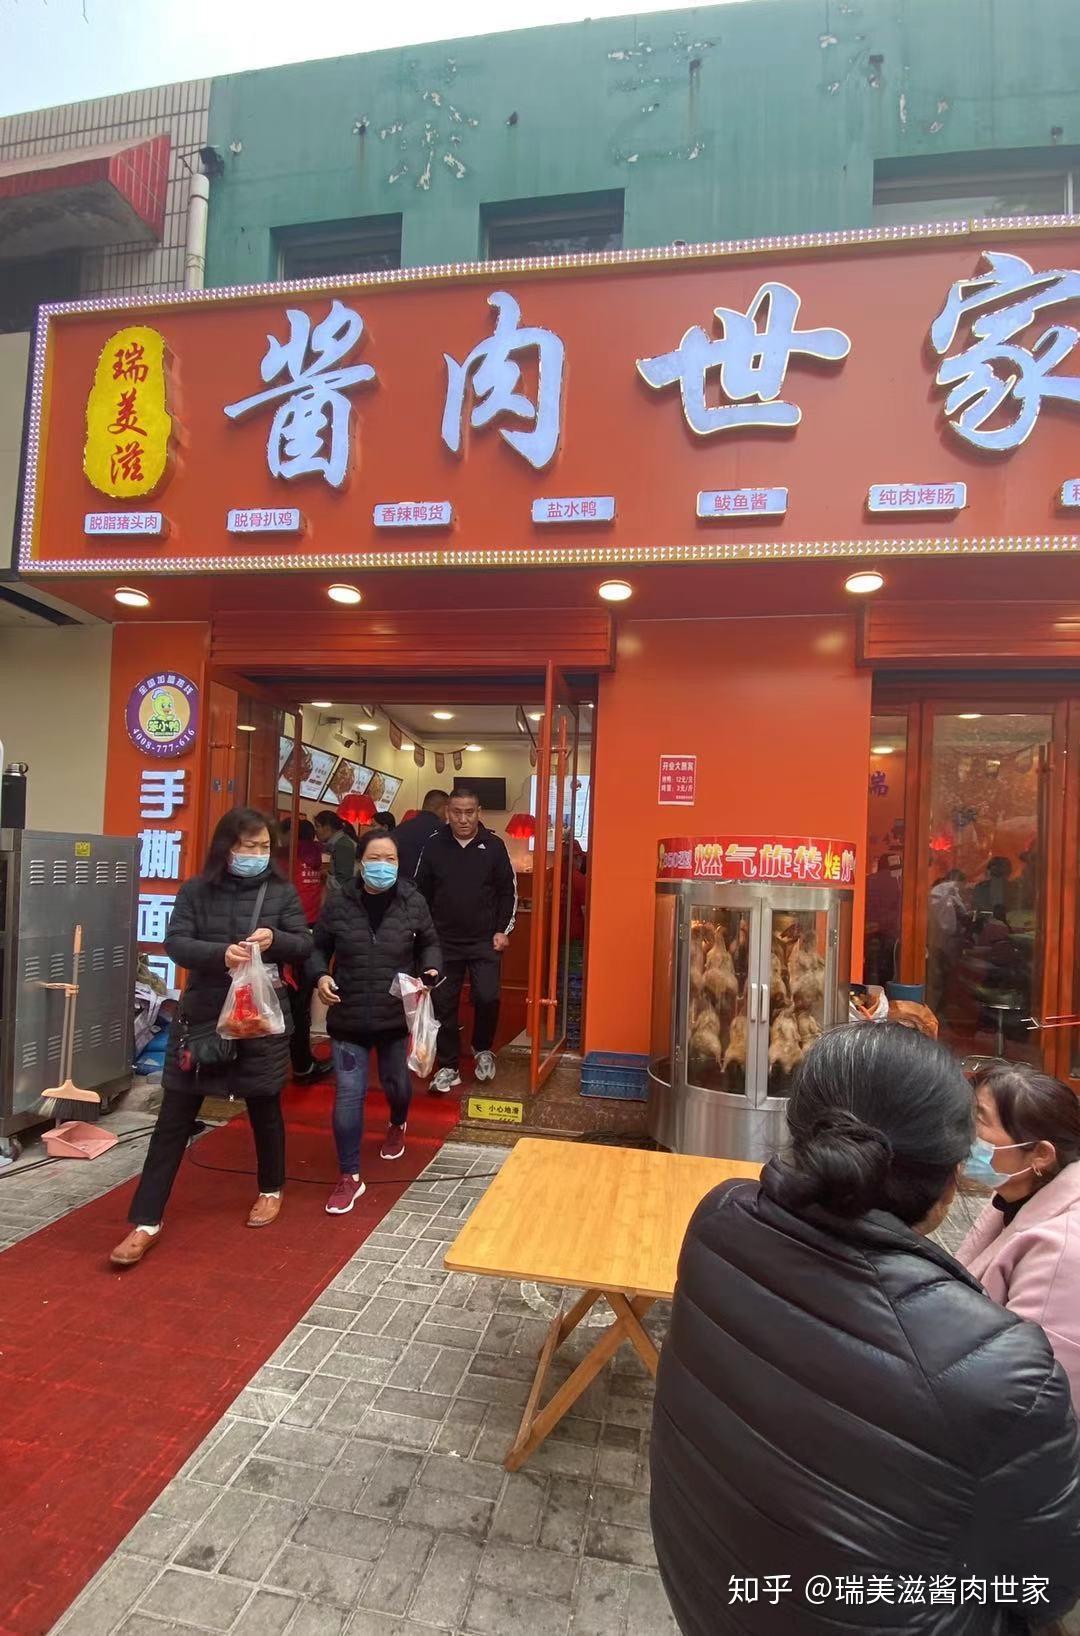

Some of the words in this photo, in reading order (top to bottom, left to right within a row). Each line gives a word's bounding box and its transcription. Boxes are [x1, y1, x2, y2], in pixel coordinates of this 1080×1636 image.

[107, 342, 149, 485] 瑞美滋
[712, 492, 769, 512] 鲅鱼酱
[877, 487, 956, 507] 纯肉烤肠
[233, 509, 293, 528] 脱骨扒鸡
[380, 504, 444, 524] 香辣鸭货
[546, 501, 598, 519] 盐水鸭
[89, 513, 158, 531] 脱脂猪头肉
[133, 728, 196, 753] 4008-777-616
